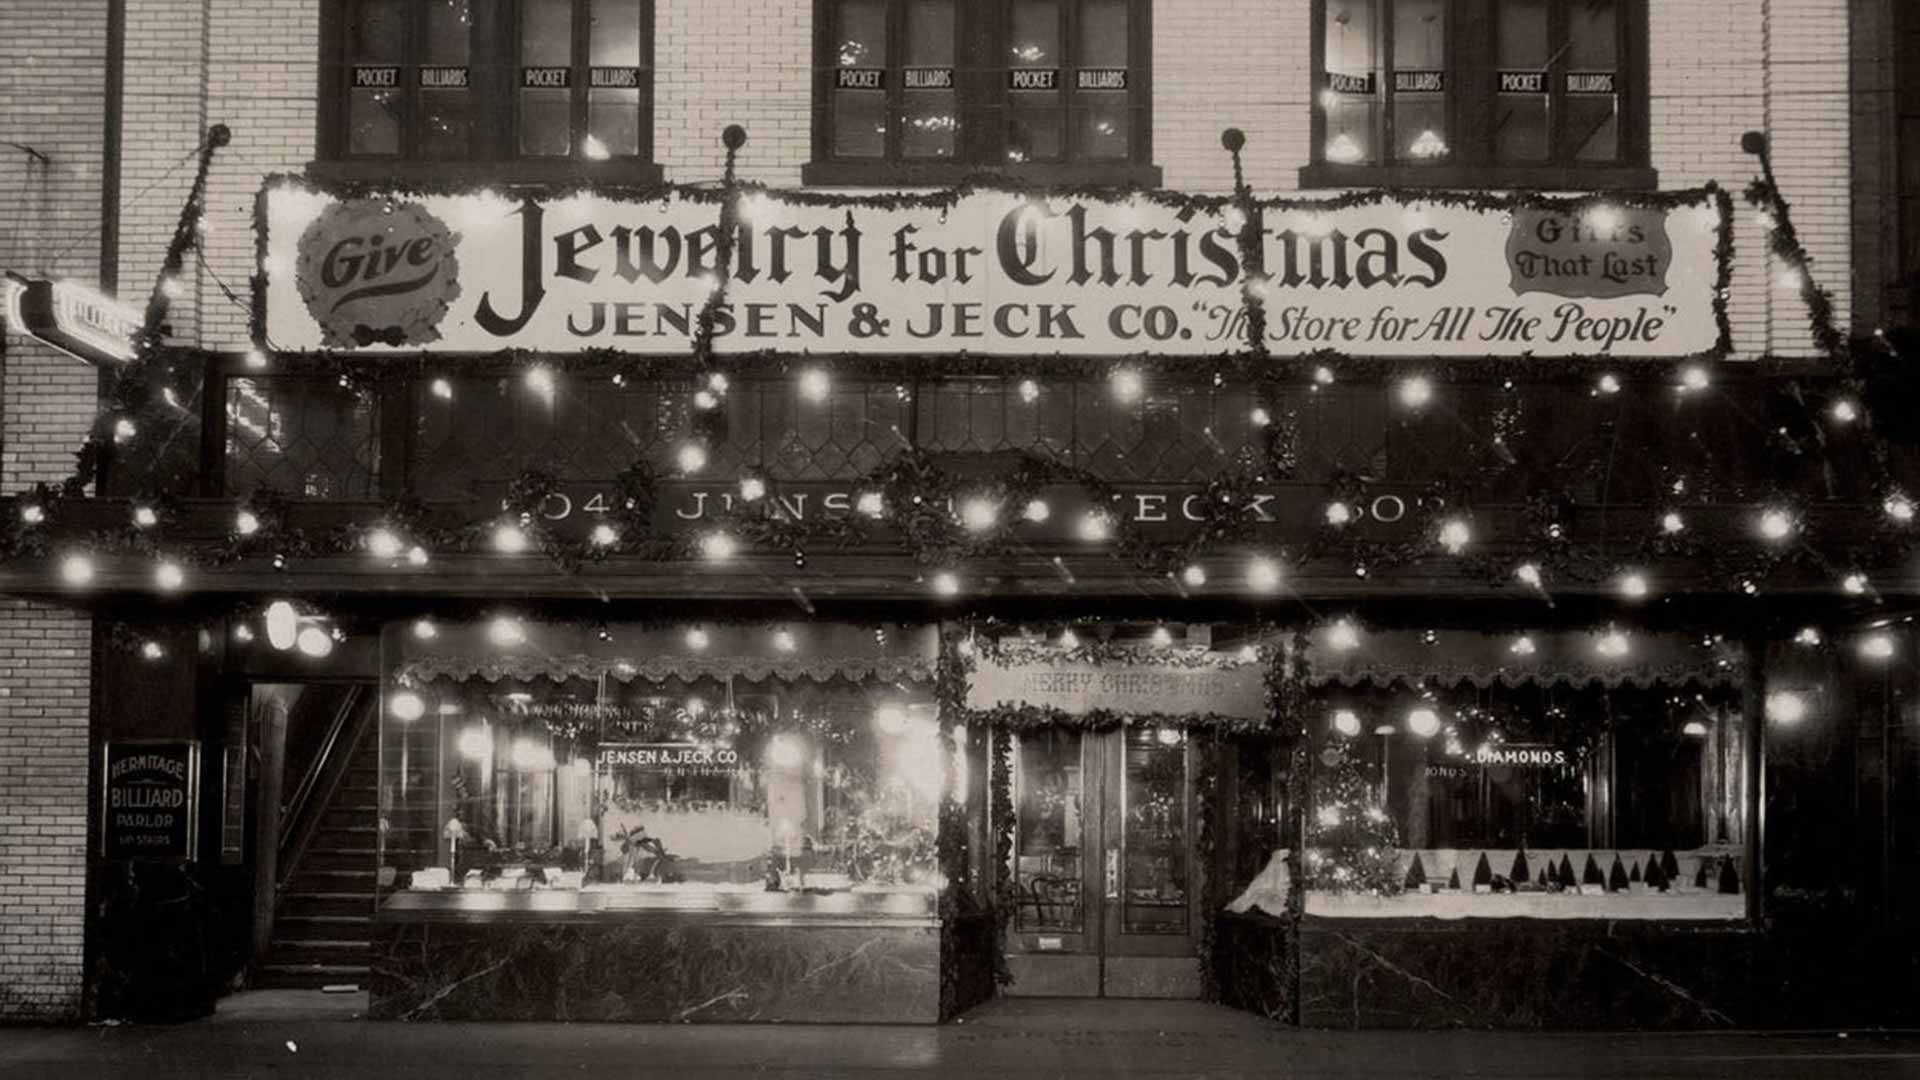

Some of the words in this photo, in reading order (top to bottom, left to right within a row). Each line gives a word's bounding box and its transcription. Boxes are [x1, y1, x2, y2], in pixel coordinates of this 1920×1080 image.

[357, 69, 396, 85] POCKET
[421, 69, 466, 86] BILLIARDS
[526, 69, 567, 85] POCKET
[591, 69, 637, 86] BILLIARDS
[840, 70, 880, 87] POCKET
[905, 70, 950, 86] BILLIARDS
[1013, 71, 1053, 88] POCKET
[1079, 71, 1124, 87] BILLIARDS
[1330, 74, 1369, 91] POCKET
[1396, 73, 1441, 90] BILLIARDS
[1502, 74, 1541, 91] POCKET
[1567, 75, 1612, 91] BILLIARDS
[321, 235, 432, 288] Give
[474, 200, 862, 337] Jewelry
[889, 223, 982, 285] for
[1515, 251, 1592, 279] That
[1601, 252, 1658, 284] Last
[567, 302, 828, 338] JENSEN
[847, 303, 890, 338] &
[906, 303, 1085, 339] JECK
[1108, 304, 1192, 341] CO.
[1269, 306, 1361, 341] Store
[1366, 306, 1418, 342] for
[1413, 307, 1475, 341] All
[1479, 306, 1541, 342] The
[1547, 303, 1677, 351] People”
[1023, 672, 1092, 694] MERRY
[598, 750, 657, 764] JENSEN
[673, 750, 714, 764] JECK
[717, 750, 738, 764] CO
[1477, 750, 1566, 763] DIAMONDS
[111, 755, 185, 781] HERMITAGE
[111, 787, 184, 808] BILLIARD
[116, 813, 175, 828] PARLOR
